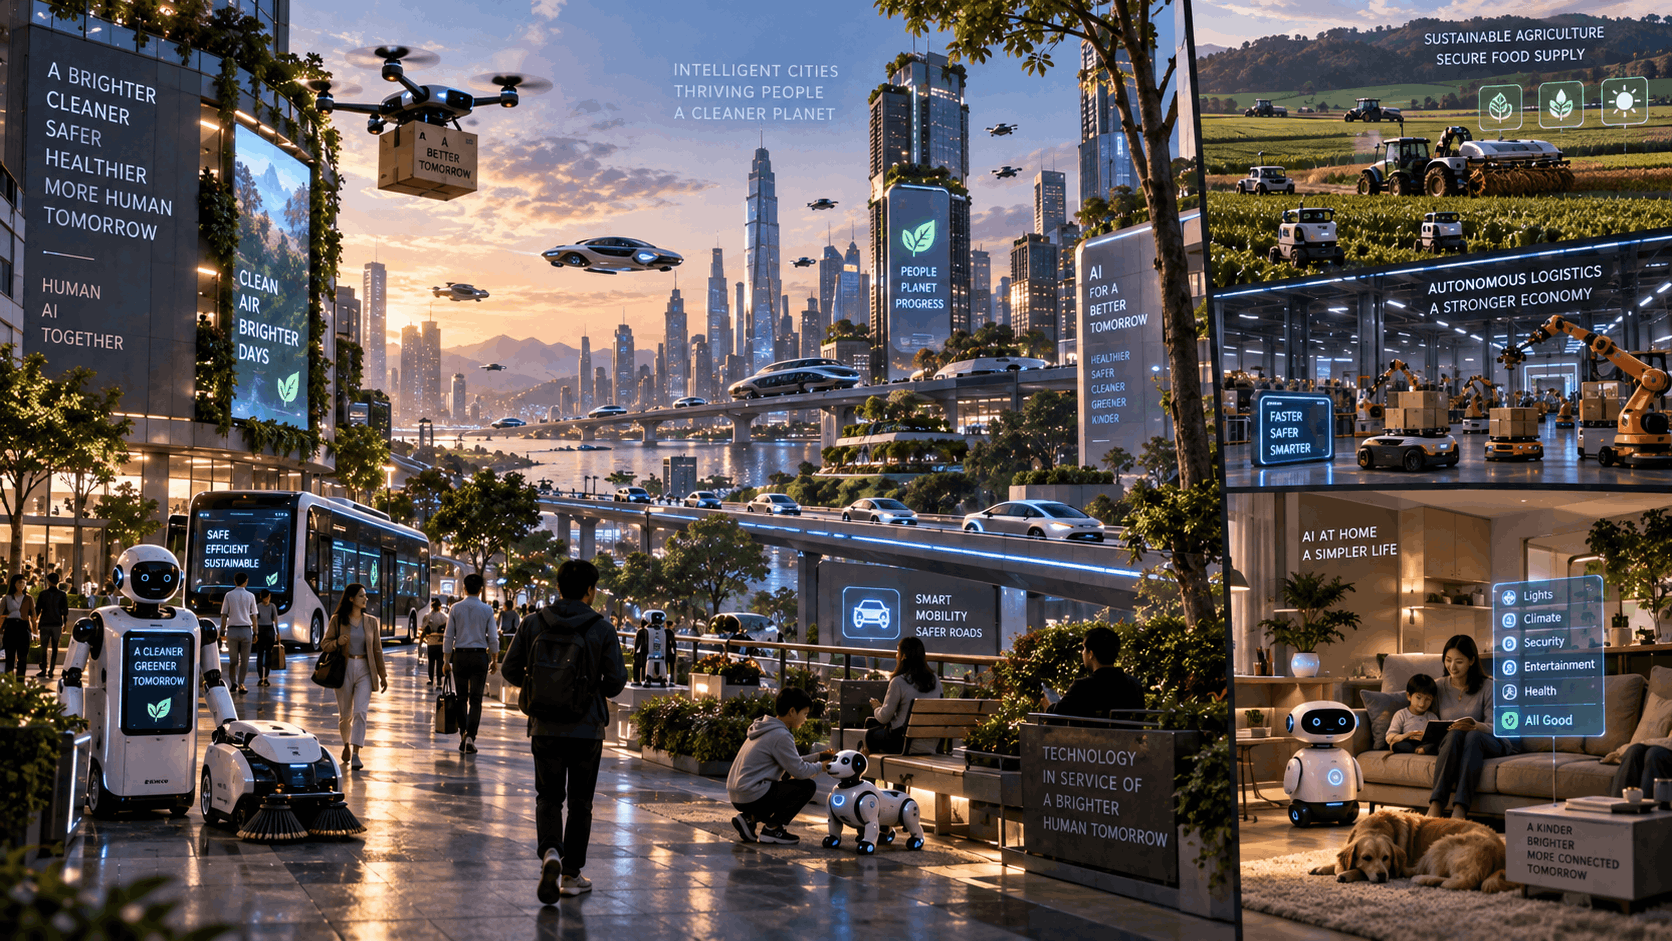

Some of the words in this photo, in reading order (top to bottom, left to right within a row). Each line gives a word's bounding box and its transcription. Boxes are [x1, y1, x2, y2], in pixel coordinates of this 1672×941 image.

[48, 62, 61, 80] A
[69, 66, 156, 104] BRIGHTER
[47, 91, 130, 126] CLEANER
[46, 120, 101, 147] SAFER
[442, 137, 448, 147] A
[427, 148, 459, 163] BETTER
[46, 148, 147, 184] HEALTHIER
[419, 160, 471, 179] TOMORROW
[45, 177, 98, 203] MORE
[106, 189, 172, 216] HUMAN
[43, 206, 157, 241] TOMORROW
[901, 266, 937, 277] PEOPLE
[1089, 265, 1101, 281] AI
[43, 278, 100, 299] HUMAN
[240, 270, 278, 295] CLEAN
[901, 283, 937, 293] PLANET
[1090, 285, 1108, 298] FOR
[1111, 283, 1118, 294] A
[239, 294, 260, 314] AIR
[896, 299, 944, 309] PROGRESS
[1090, 299, 1126, 316] BETTER
[42, 303, 57, 318] AI
[1090, 314, 1148, 333] TOMORROW
[41, 327, 123, 350] TOGETHER
[240, 319, 298, 347] BRIGHTER
[239, 343, 269, 364] DAYS
[1091, 368, 1114, 379] SAFER
[1091, 382, 1125, 394] CLEANER
[1092, 398, 1126, 409] GREENER
[1092, 414, 1119, 424] KINDER
[1270, 411, 1303, 422] FASTER
[1270, 428, 1299, 439] SAFER
[1270, 443, 1311, 455] SMARTER
[207, 530, 229, 539] SAFE
[206, 545, 249, 554] EFFICIENT
[205, 559, 259, 568] SUSTAINABLE
[916, 594, 952, 605] SMART
[1524, 591, 1553, 602] Lights
[916, 610, 968, 621] MOBILITY
[1524, 613, 1561, 624] Climate
[916, 626, 946, 637] SAFER
[950, 628, 982, 638] ROADS
[1524, 637, 1565, 648] Security
[134, 647, 140, 656] A
[143, 647, 183, 656] CLEANER
[135, 662, 176, 671] GREENER
[1525, 660, 1595, 672] Entertainment
[133, 676, 185, 686] TOMORROW
[1525, 686, 1557, 696] Health
[1525, 715, 1539, 726] All
[1543, 715, 1573, 726] Good
[1043, 746, 1136, 766] TECHNOLOGY
[1043, 769, 1055, 784] IN
[1061, 771, 1117, 790] SERVICE
[1123, 777, 1142, 793] OF
[1043, 793, 1051, 806] A
[1056, 794, 1119, 816] BRIGHTER
[1044, 816, 1086, 835] HUMAN
[1091, 822, 1168, 847] TOMORROW
[1527, 823, 1533, 832] A
[1537, 823, 1572, 835] KINDER
[1527, 836, 1575, 850] BRIGHTER
[1527, 850, 1554, 862] MORE
[1558, 853, 1619, 870] CONNECTED
[1527, 864, 1587, 880] TOMORROW
